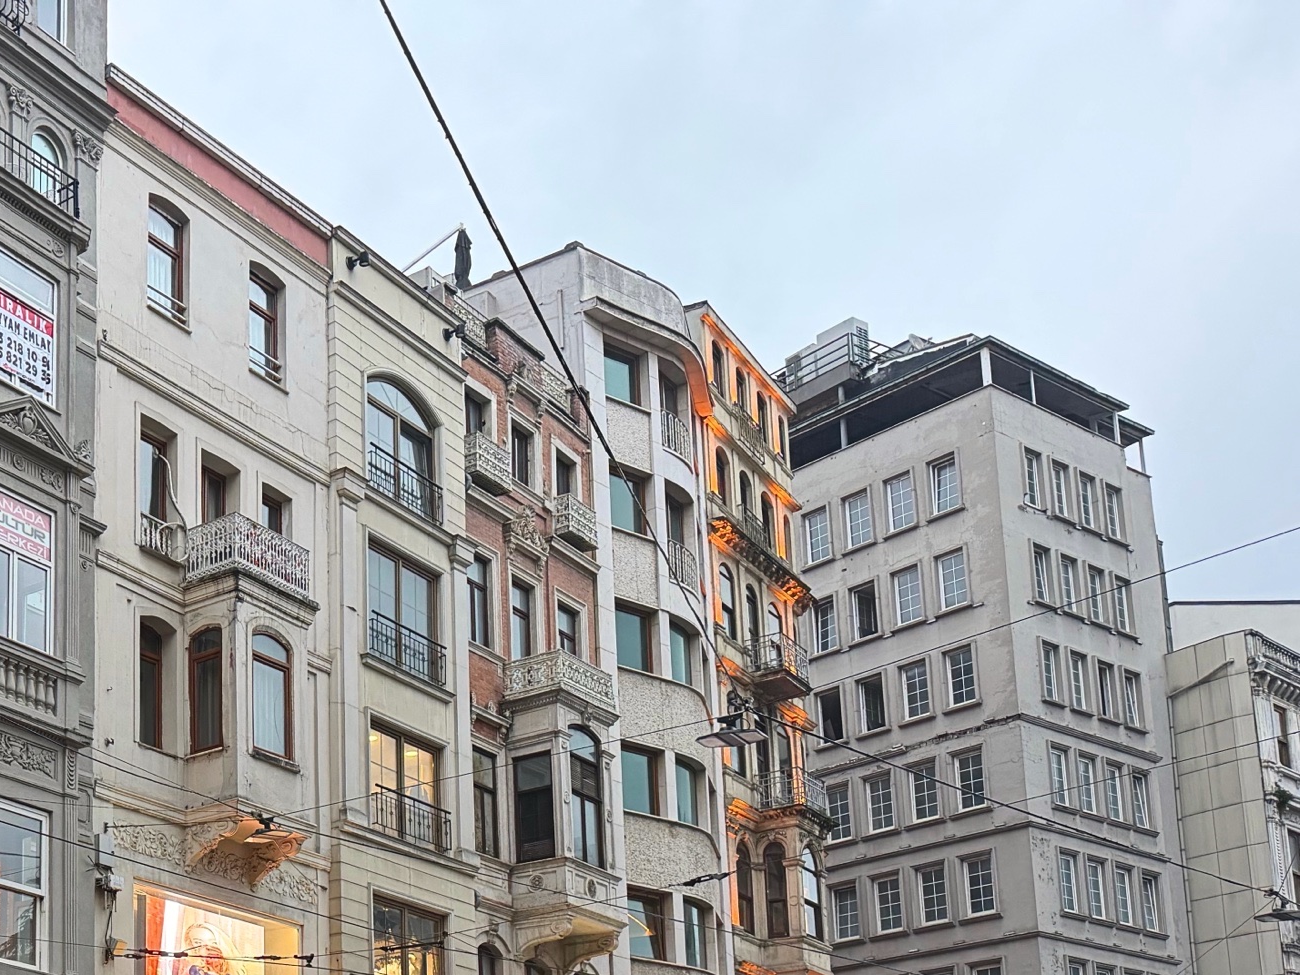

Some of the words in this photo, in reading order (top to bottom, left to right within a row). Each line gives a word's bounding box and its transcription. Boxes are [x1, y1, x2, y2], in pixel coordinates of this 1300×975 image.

[6, 337, 24, 356] 218
[27, 348, 38, 363] 10
[5, 351, 22, 370] 821
[25, 361, 38, 377] 29
